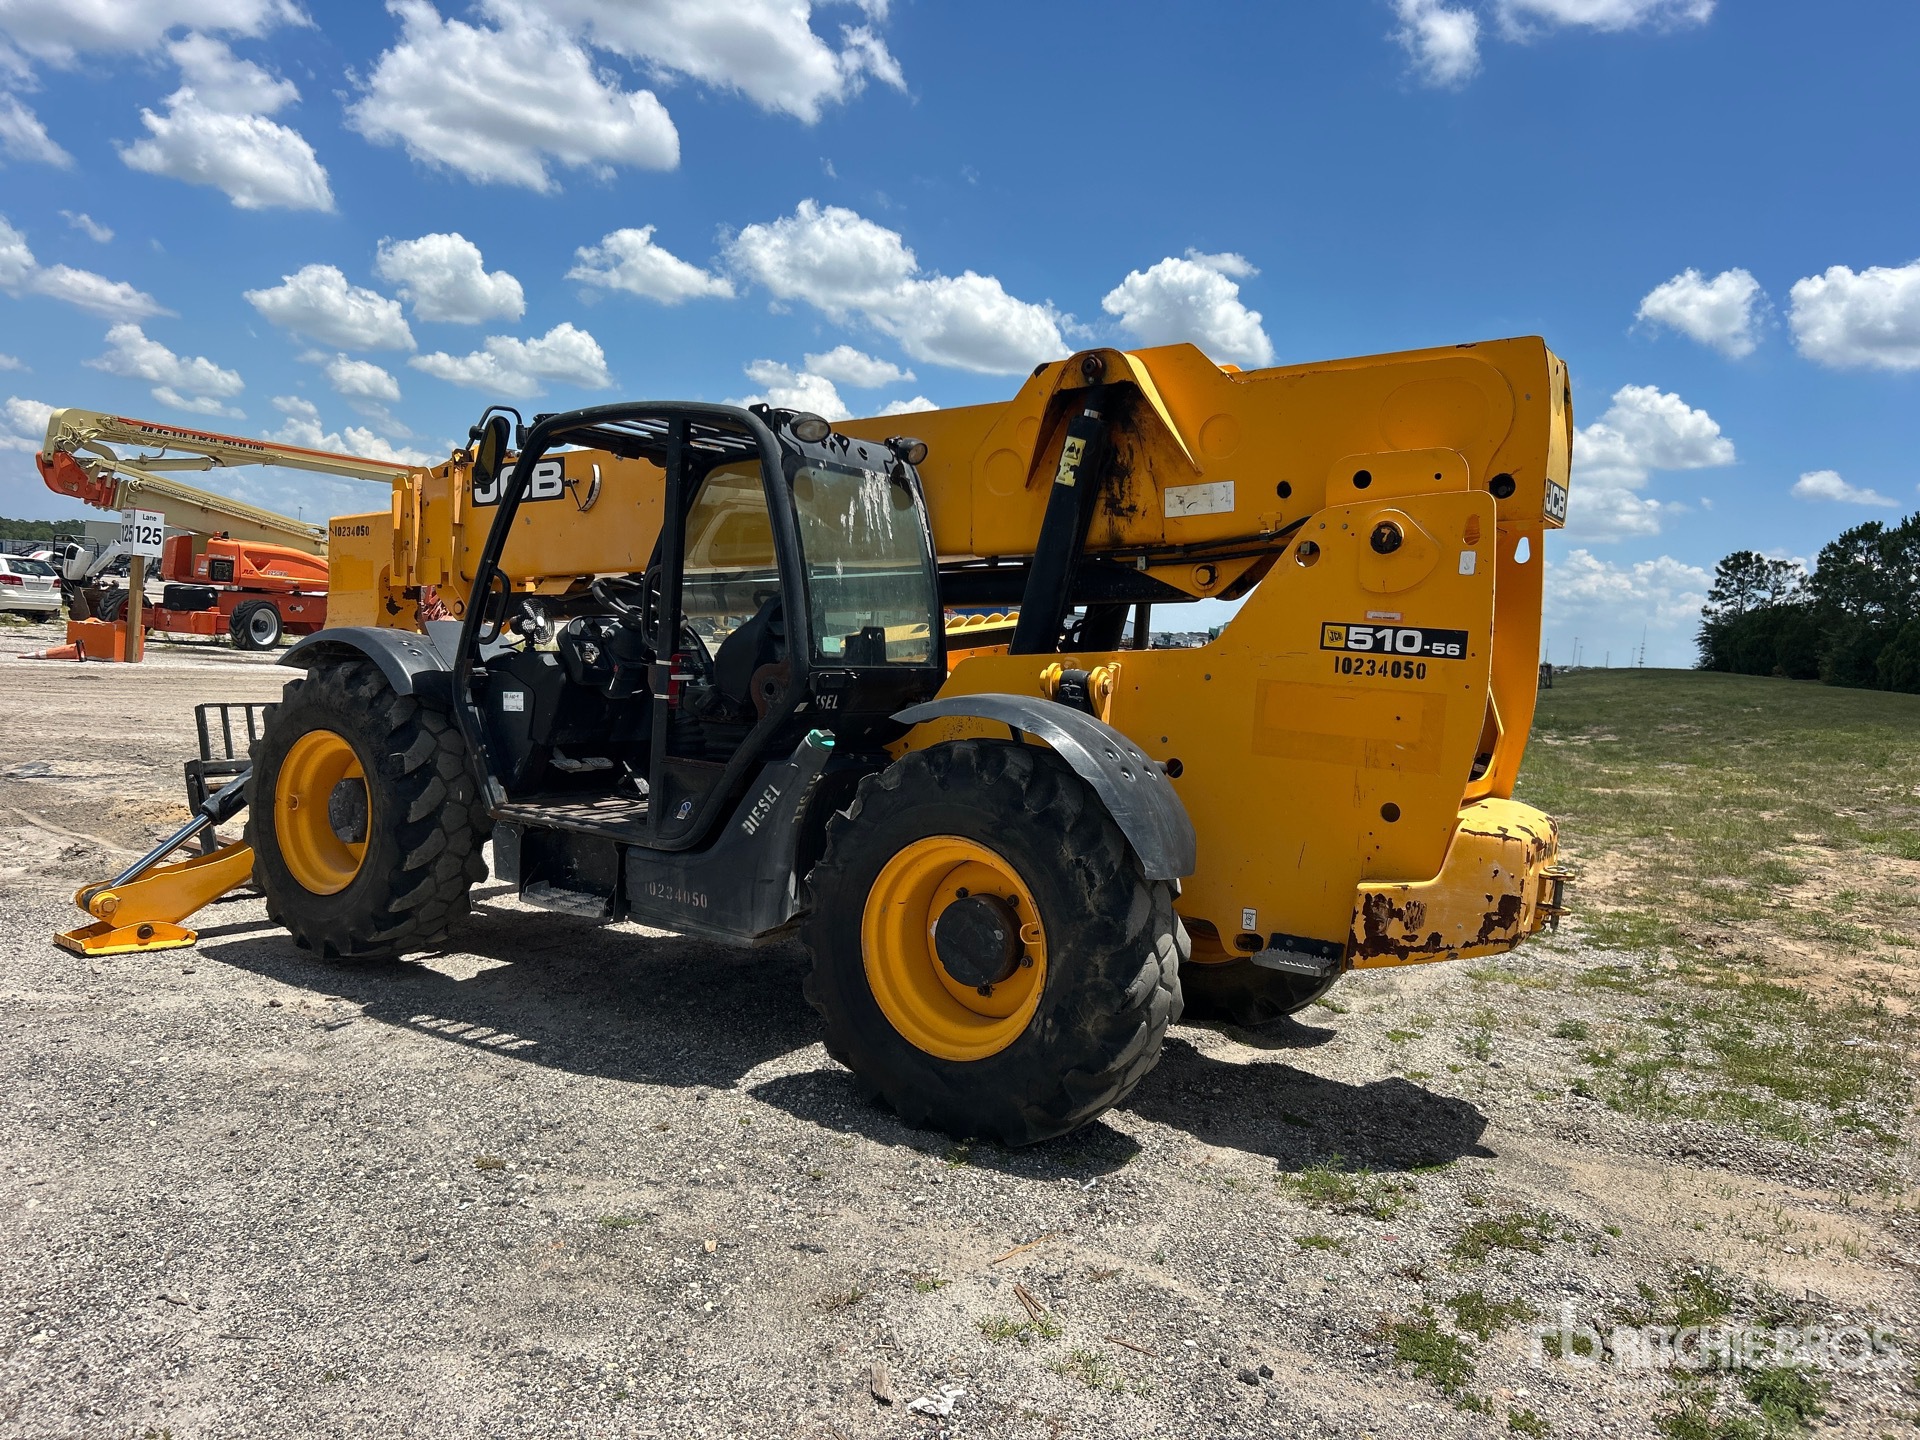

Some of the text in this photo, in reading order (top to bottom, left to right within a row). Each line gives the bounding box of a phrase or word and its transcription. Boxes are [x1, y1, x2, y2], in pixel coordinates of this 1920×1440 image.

[1545, 483, 1566, 519] JCB
[142, 513, 157, 521] Lane
[121, 524, 133, 543] 125
[135, 525, 162, 546] 125
[334, 525, 370, 537] 10234050
[1334, 656, 1427, 680] 10234050
[741, 783, 781, 836] DIESEL
